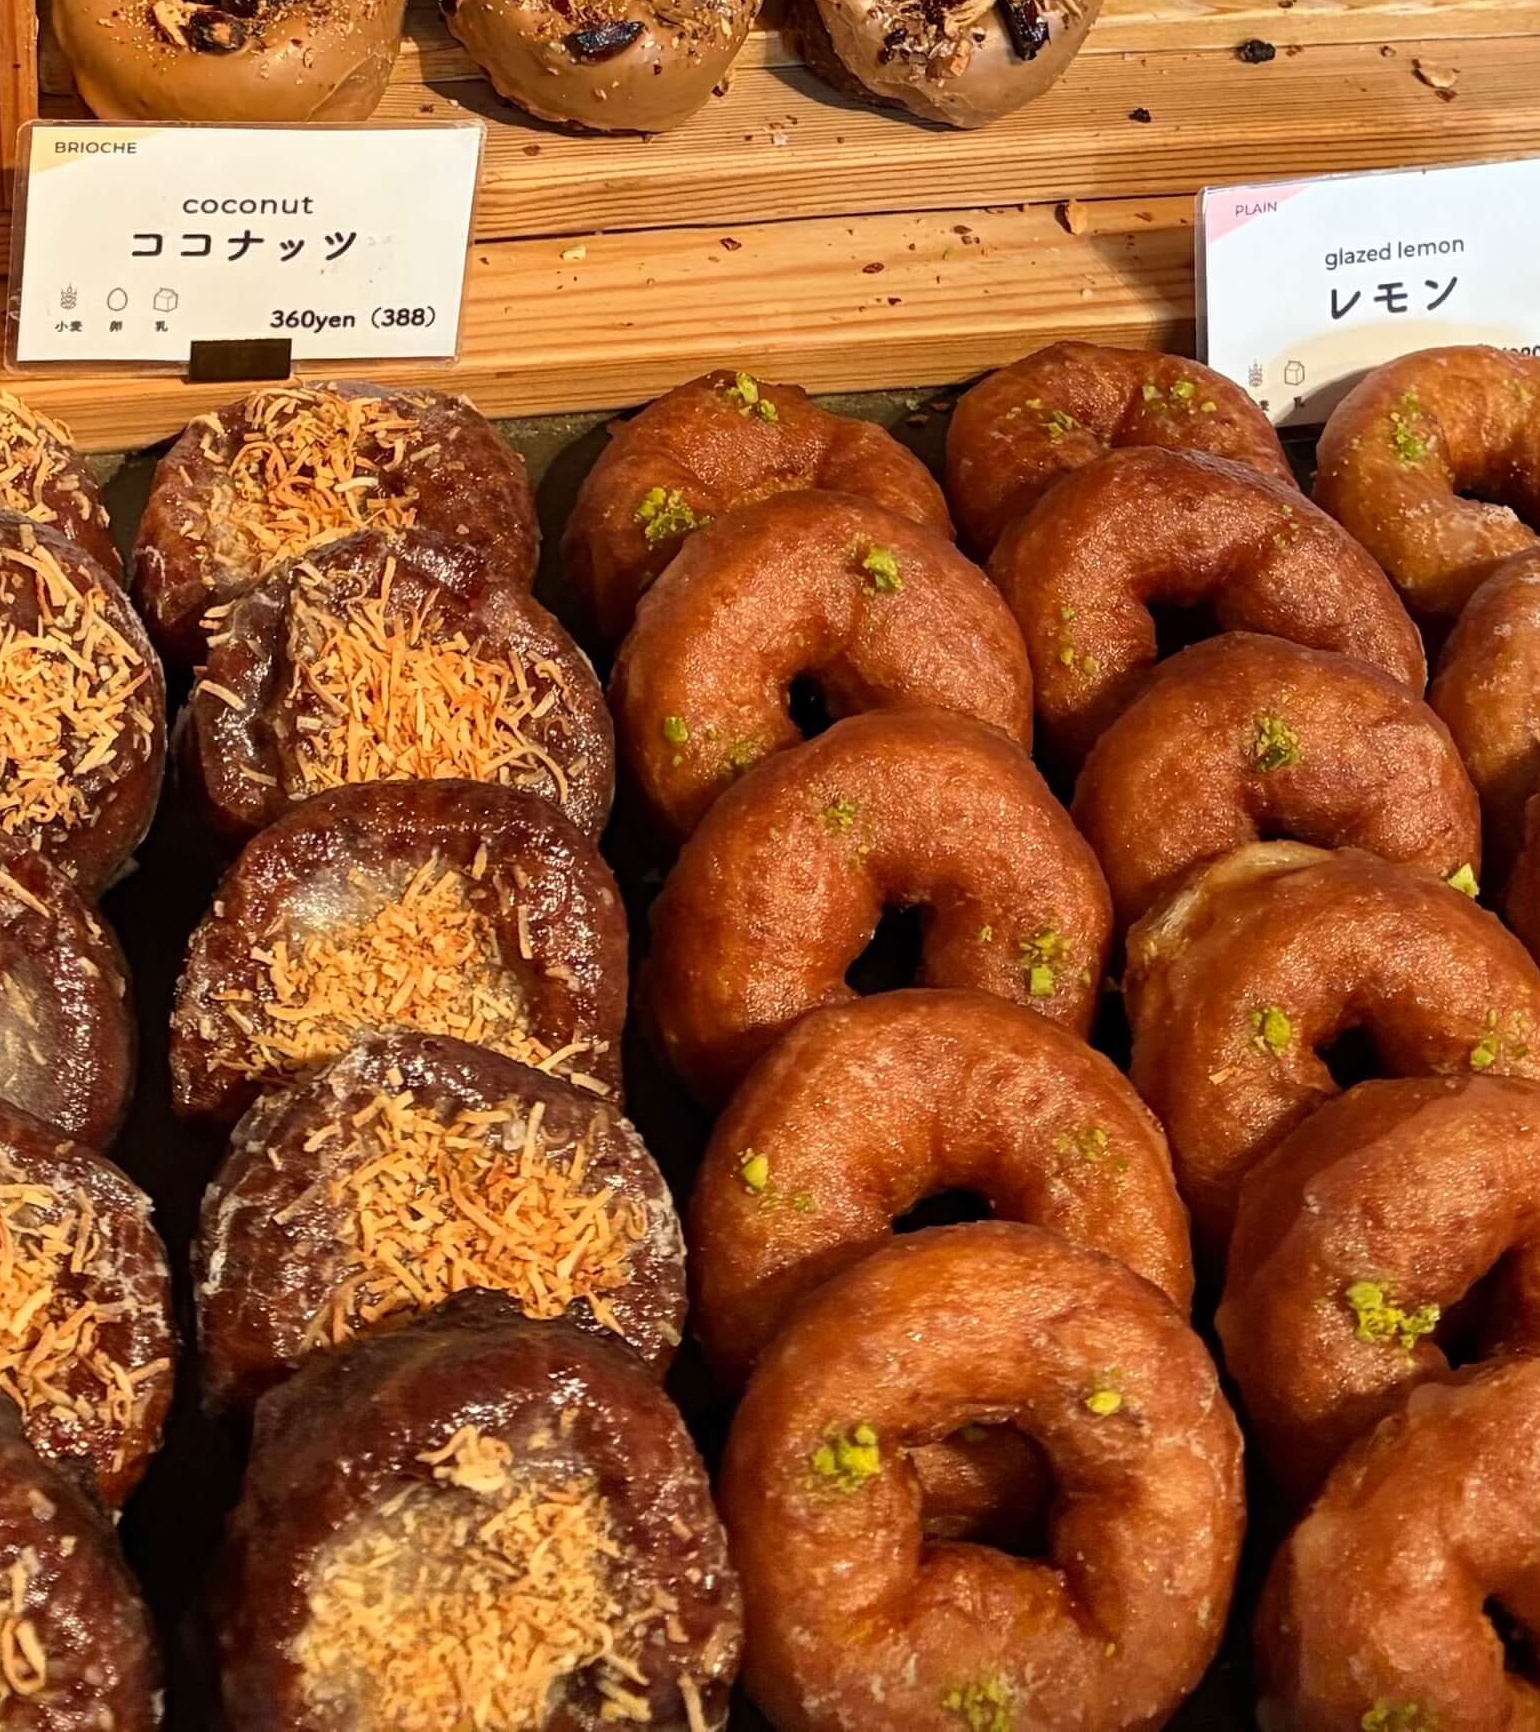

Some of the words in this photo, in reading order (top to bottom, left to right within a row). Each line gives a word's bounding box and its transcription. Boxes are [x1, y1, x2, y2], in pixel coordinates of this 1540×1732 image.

[54, 140, 138, 155] BRIOCHE
[182, 195, 315, 216] coconut
[1234, 201, 1279, 218] PLAIN
[131, 229, 358, 263] ココナッツ
[1324, 242, 1391, 271] glazed
[1397, 237, 1465, 260] lemon
[1329, 275, 1459, 321] レモン
[269, 309, 356, 333] 360yen
[371, 305, 436, 330] (388)
